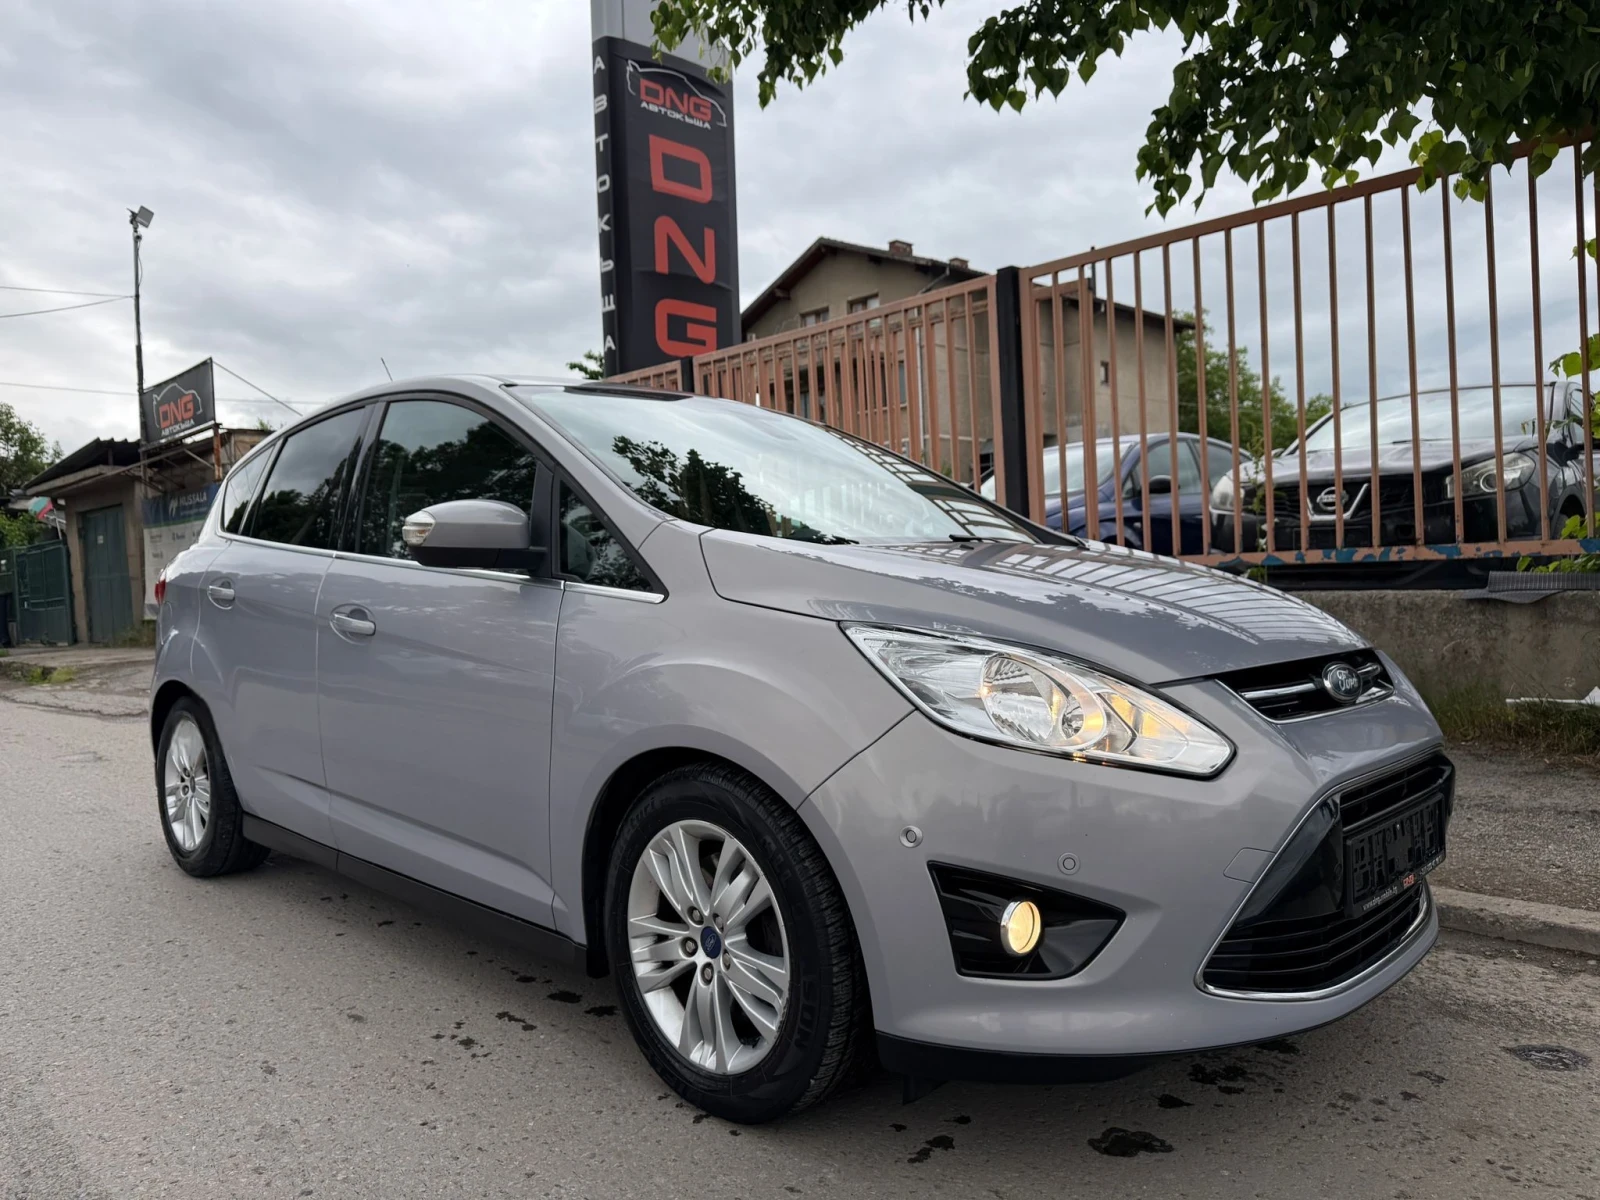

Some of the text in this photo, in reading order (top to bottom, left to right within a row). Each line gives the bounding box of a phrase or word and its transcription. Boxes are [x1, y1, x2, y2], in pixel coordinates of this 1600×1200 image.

[640, 78, 712, 122] DNG
[649, 134, 717, 358] DNG
[159, 393, 194, 429] DNG
